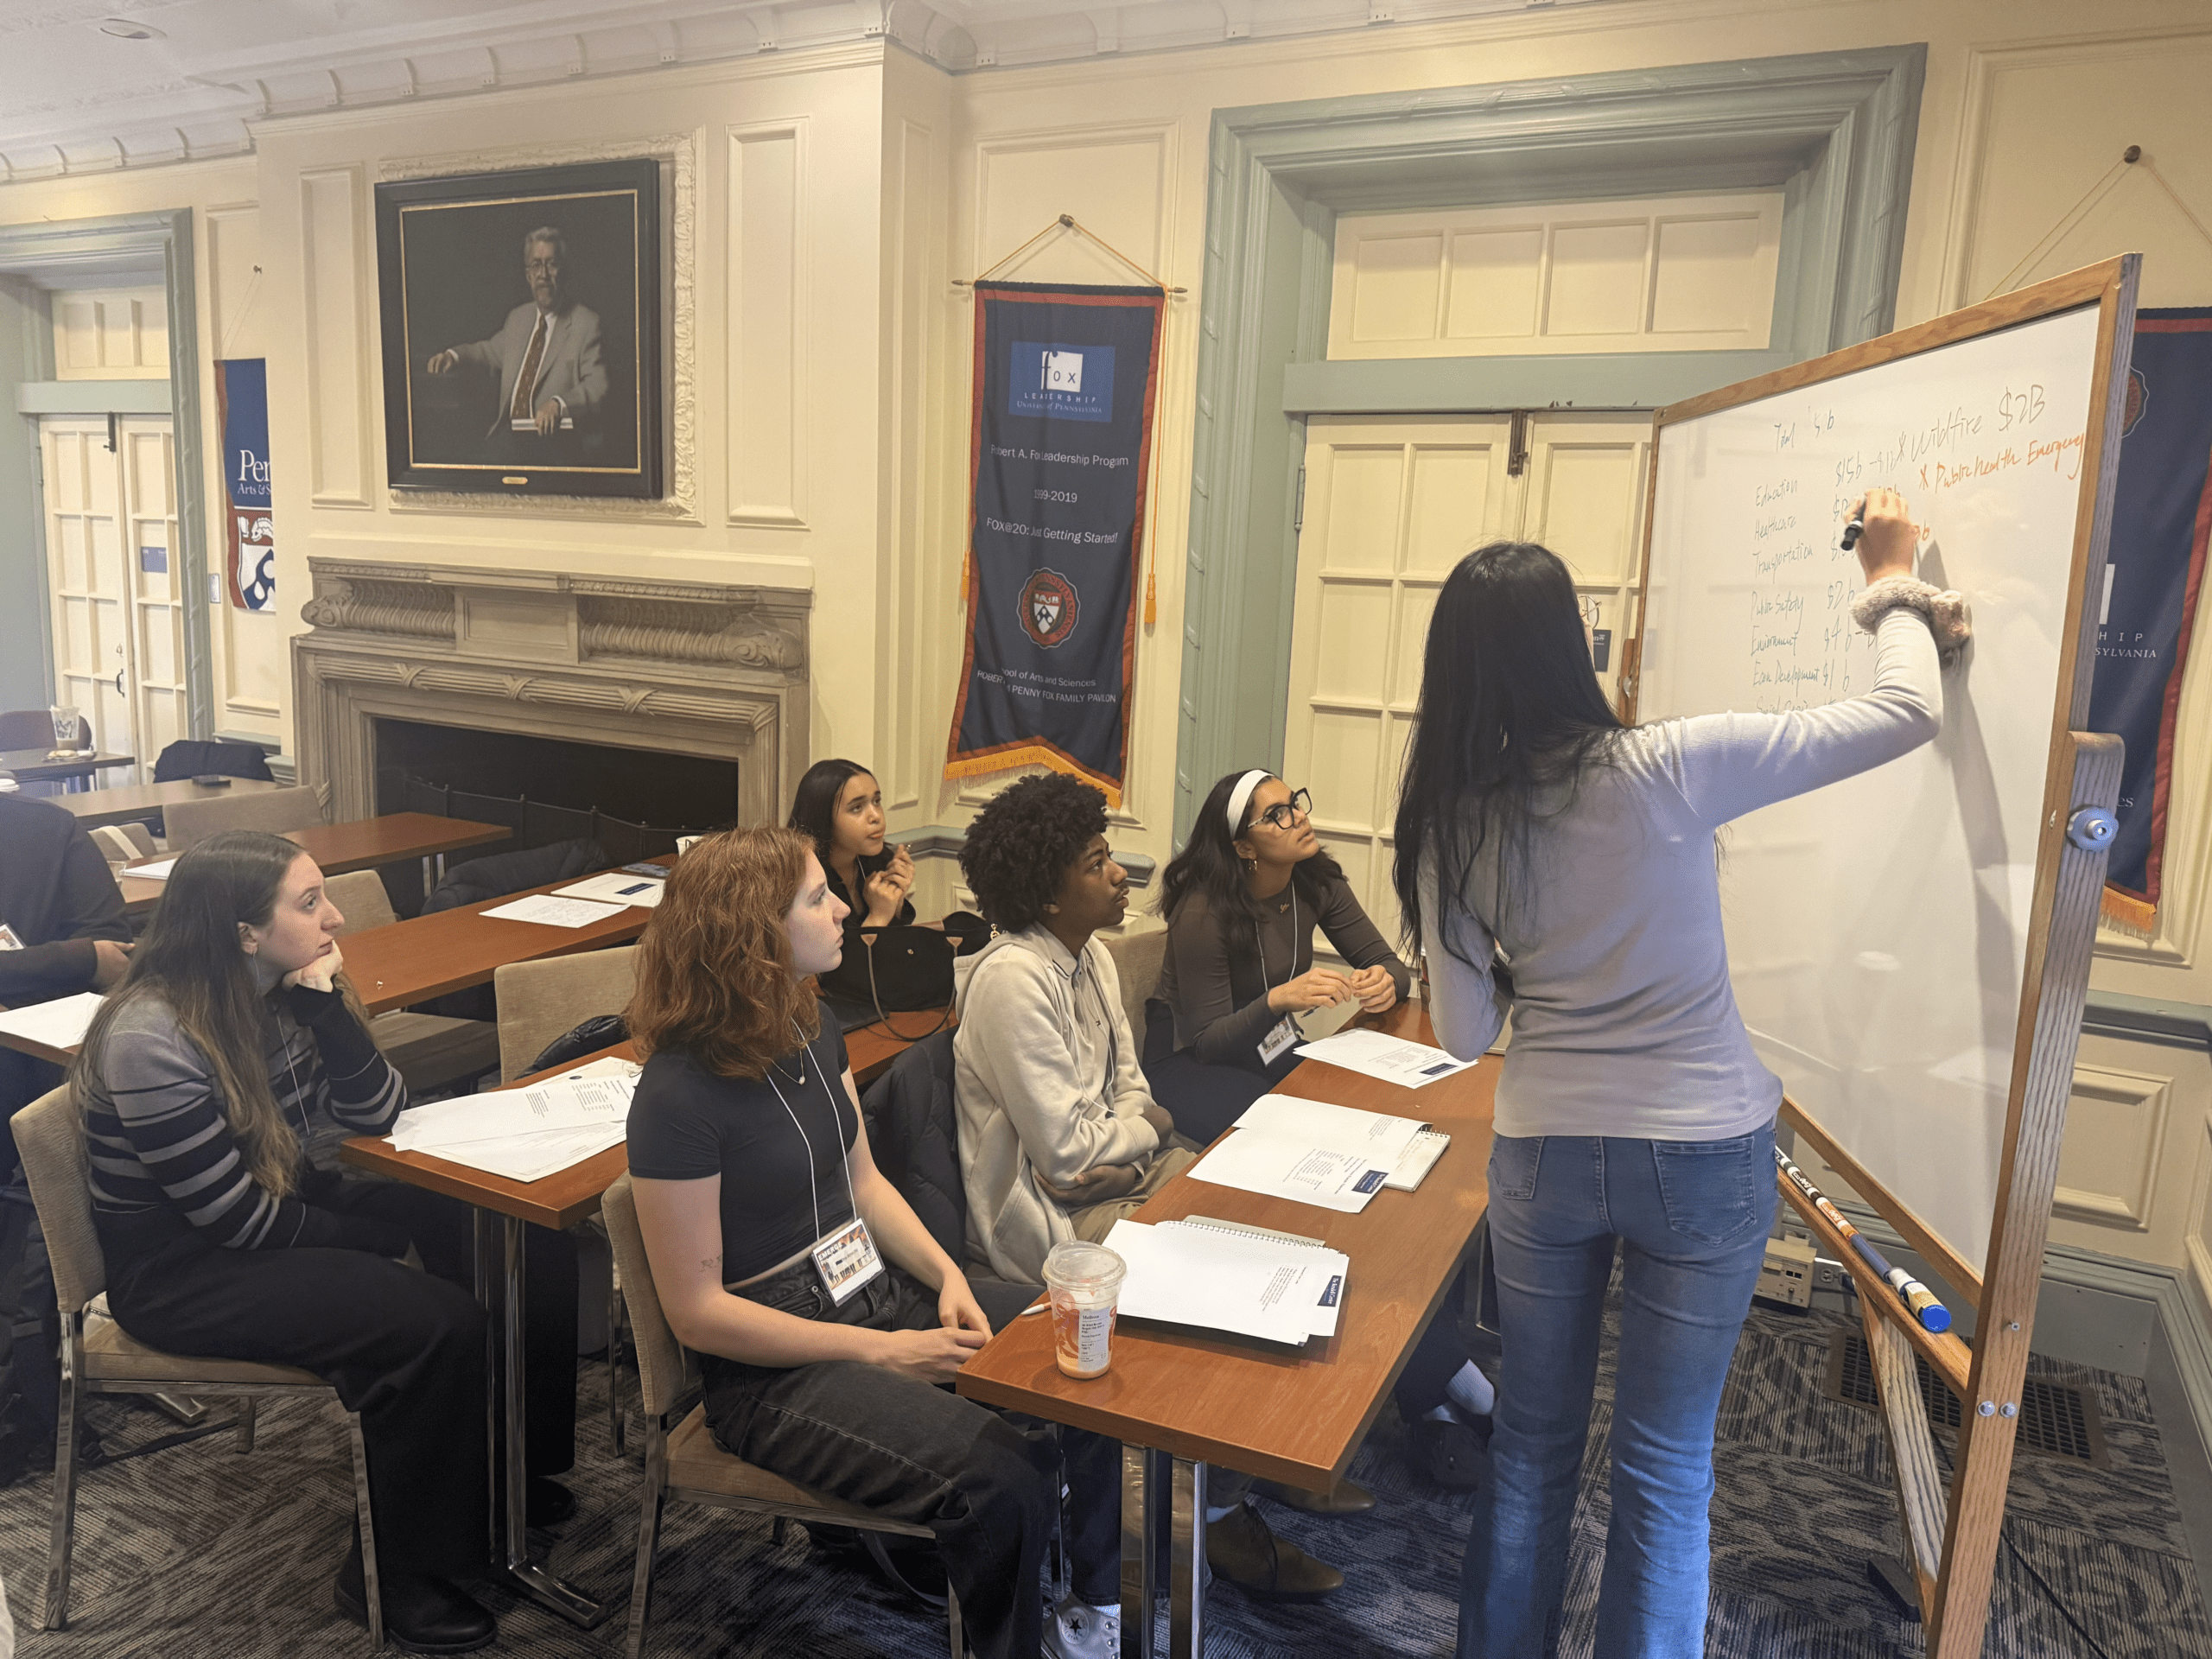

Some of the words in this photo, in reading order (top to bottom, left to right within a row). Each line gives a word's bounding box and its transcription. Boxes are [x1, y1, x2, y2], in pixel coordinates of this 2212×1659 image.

[1911, 406, 1982, 462] Wildfire
[991, 444, 1016, 458] Rbert
[1018, 448, 1027, 459] A.
[238, 483, 257, 495] Arts
[1043, 528, 1082, 544] Getting
[1084, 531, 1119, 544] Started!
[2094, 647, 2157, 658] SYLVANIA
[977, 670, 1006, 685] ROBER
[1011, 684, 1041, 698] PENNY
[1042, 690, 1055, 701] FOX
[1056, 692, 1086, 703] FAMILY
[1019, 671, 1029, 680] of
[1029, 672, 1044, 683] Arts
[1044, 677, 1057, 685] and
[1058, 677, 1096, 688] Sciences
